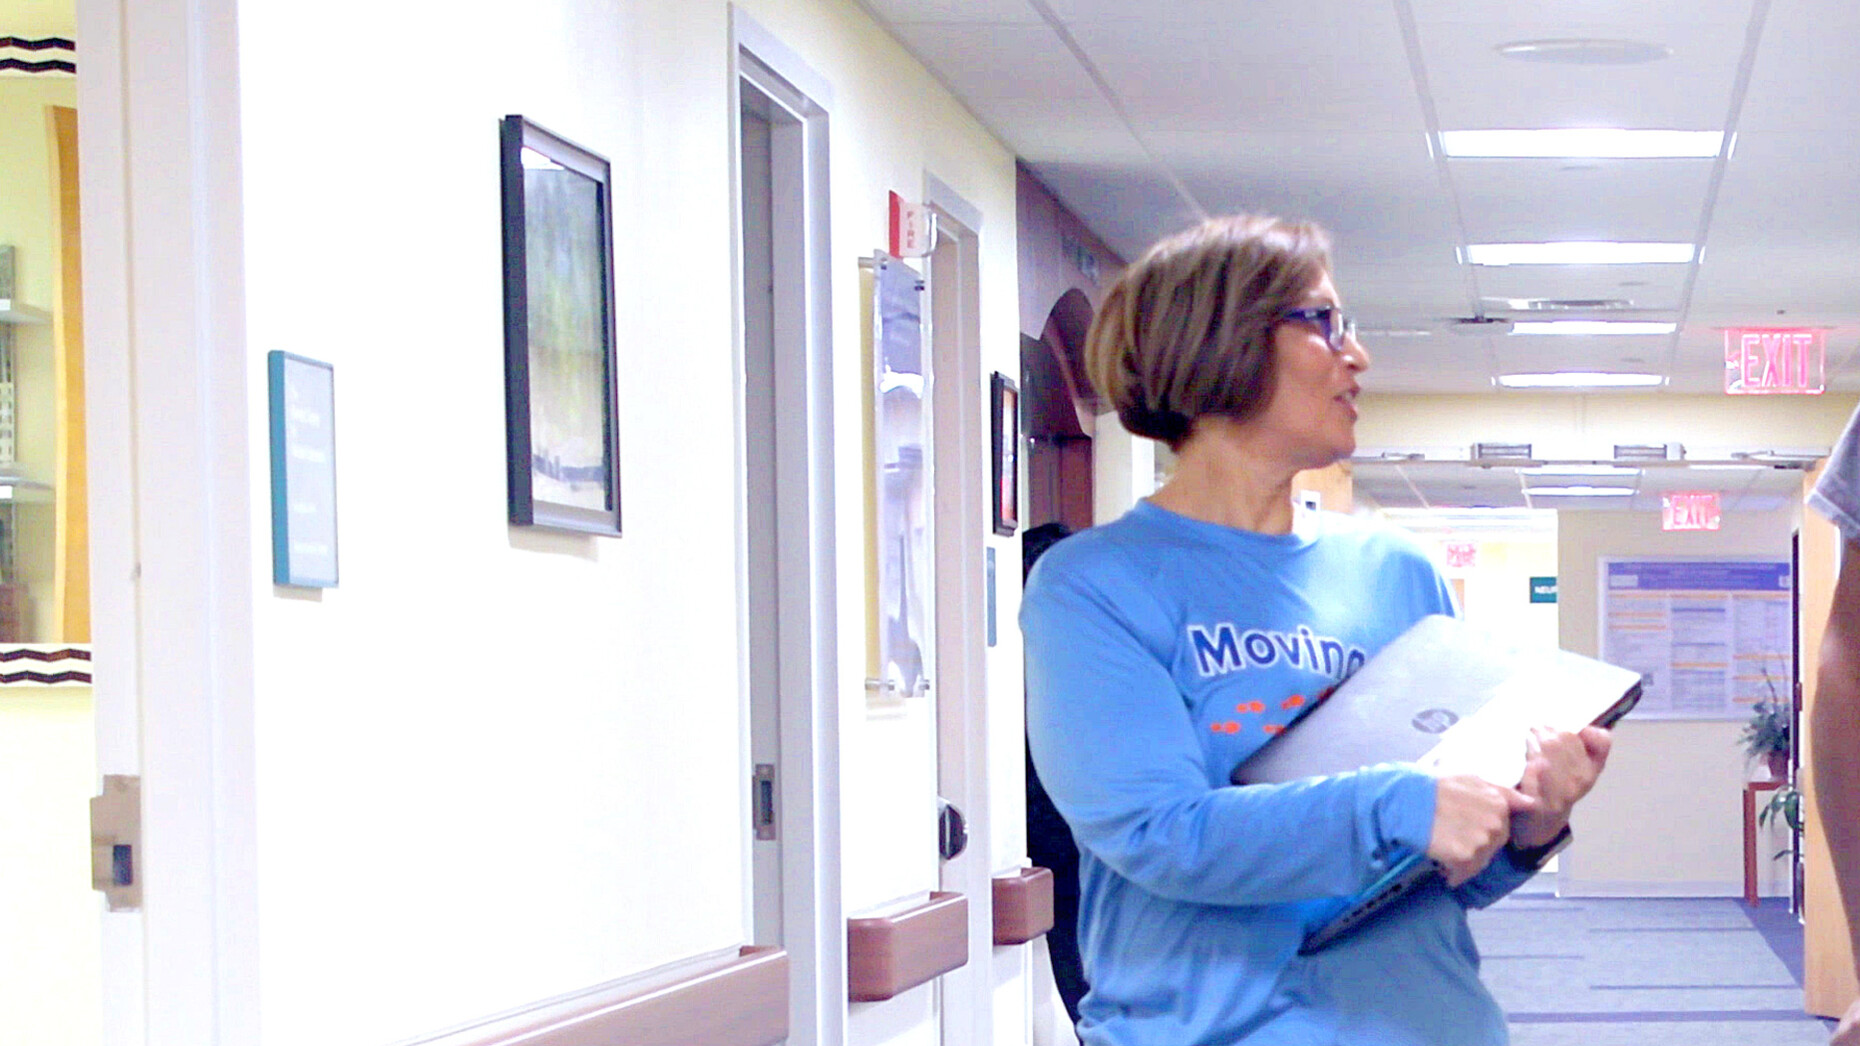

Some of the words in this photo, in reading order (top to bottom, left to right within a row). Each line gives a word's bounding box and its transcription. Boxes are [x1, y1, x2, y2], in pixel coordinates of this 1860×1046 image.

[906, 210, 915, 249] FIRE
[1742, 334, 1812, 388] EXIT
[1670, 494, 1713, 528] EXIT
